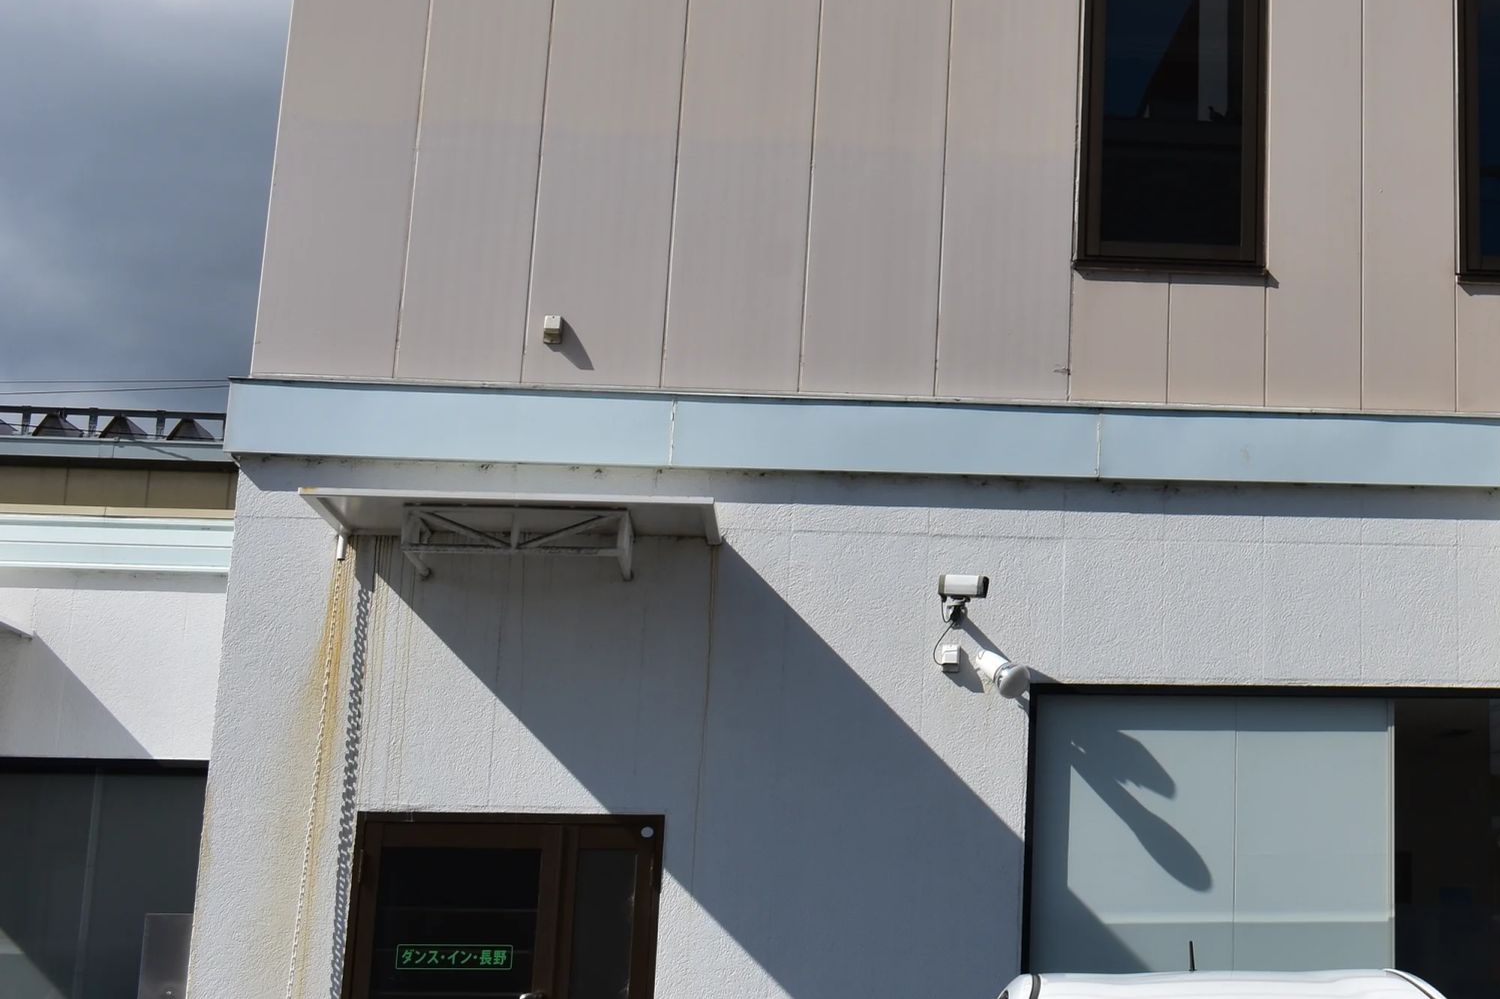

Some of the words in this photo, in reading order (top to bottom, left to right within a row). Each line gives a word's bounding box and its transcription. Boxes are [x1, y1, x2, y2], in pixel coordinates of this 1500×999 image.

[401, 948, 507, 966] ダンス・イン・長野
